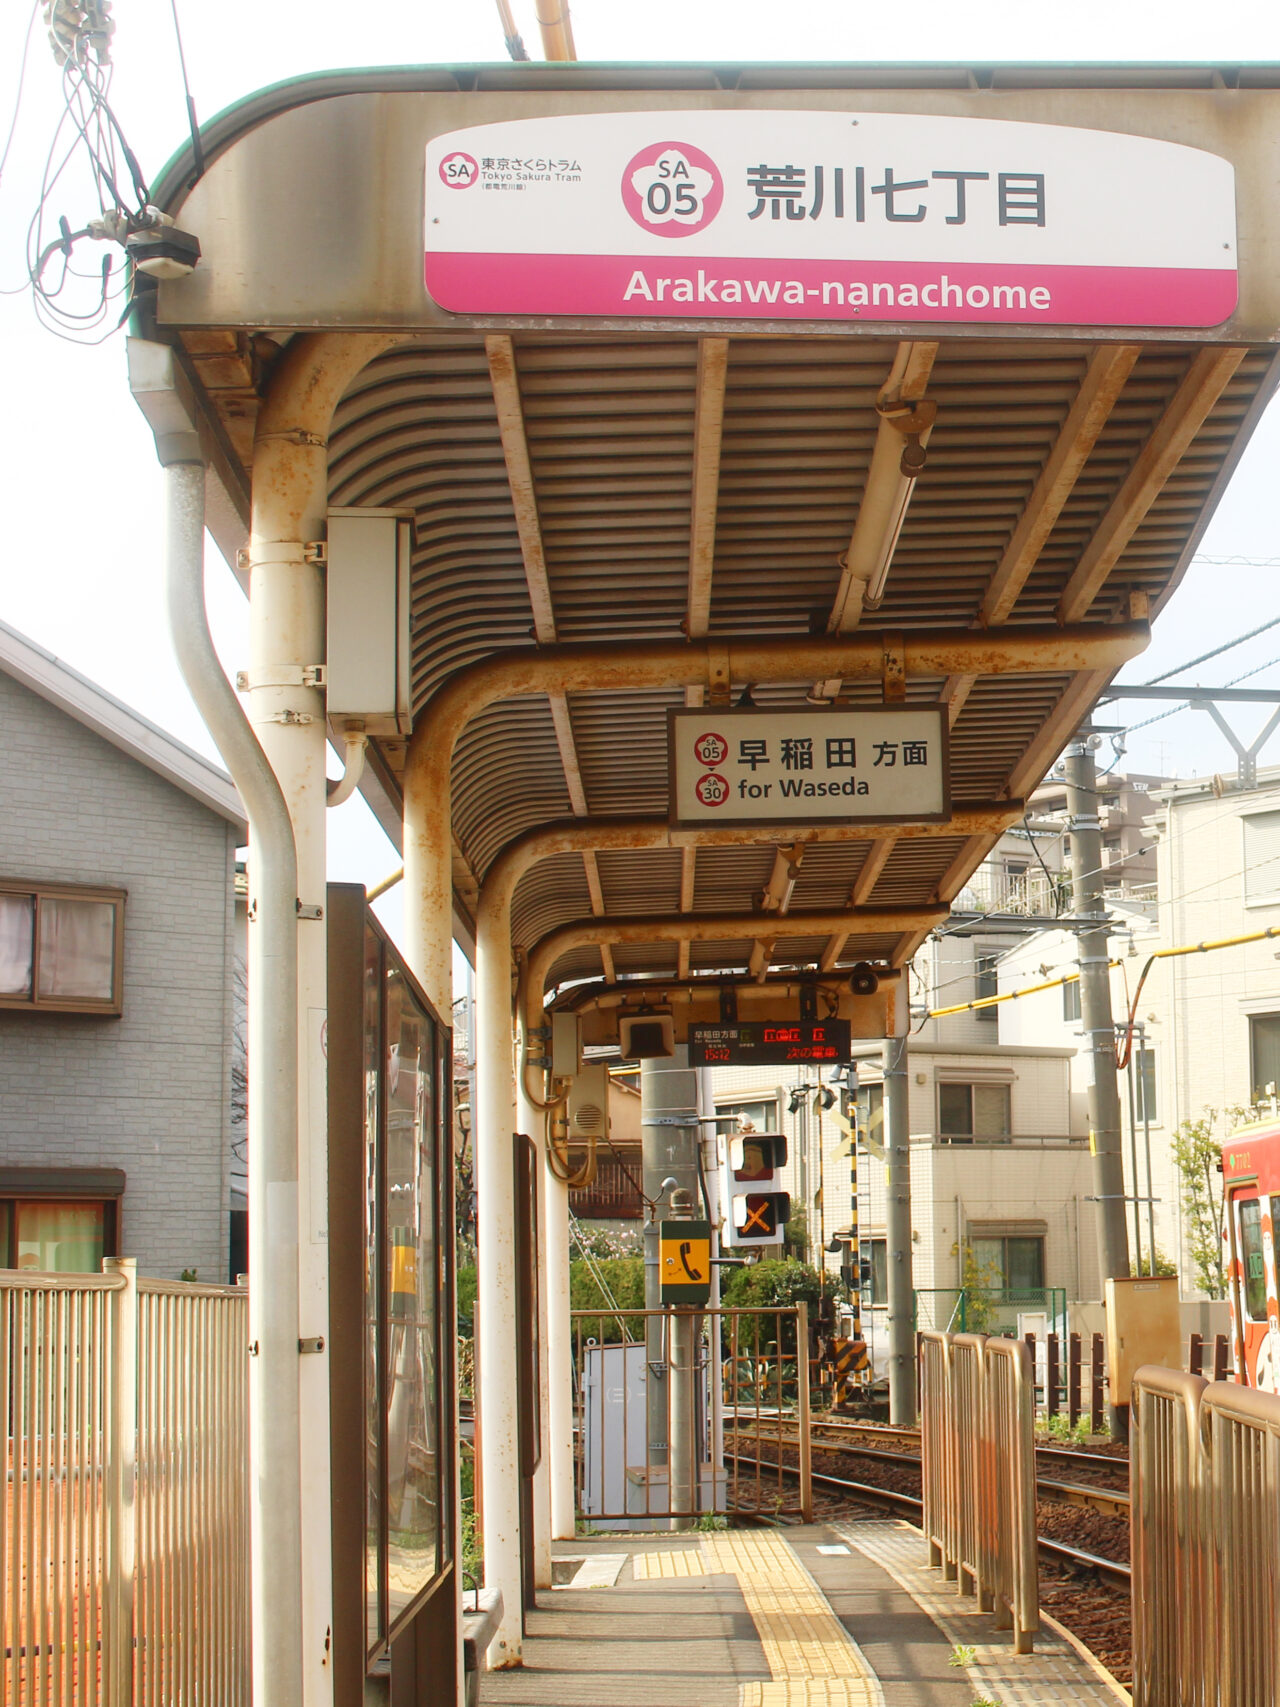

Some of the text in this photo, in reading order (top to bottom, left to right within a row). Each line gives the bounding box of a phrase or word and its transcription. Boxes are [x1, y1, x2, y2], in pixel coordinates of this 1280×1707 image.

[447, 164, 470, 178] SA
[482, 157, 582, 172] 東京さくらトラム
[659, 160, 689, 179] SA
[482, 172, 582, 182] Tokyo Sakura Tram
[647, 182, 698, 215] 05
[746, 164, 1046, 227] 荒川七丁目
[623, 270, 1051, 310] Arakawa-nanachome
[702, 747, 720, 759] 05
[707, 779, 718, 787] SA
[738, 777, 869, 799] for Waseda
[704, 788, 721, 799] 30
